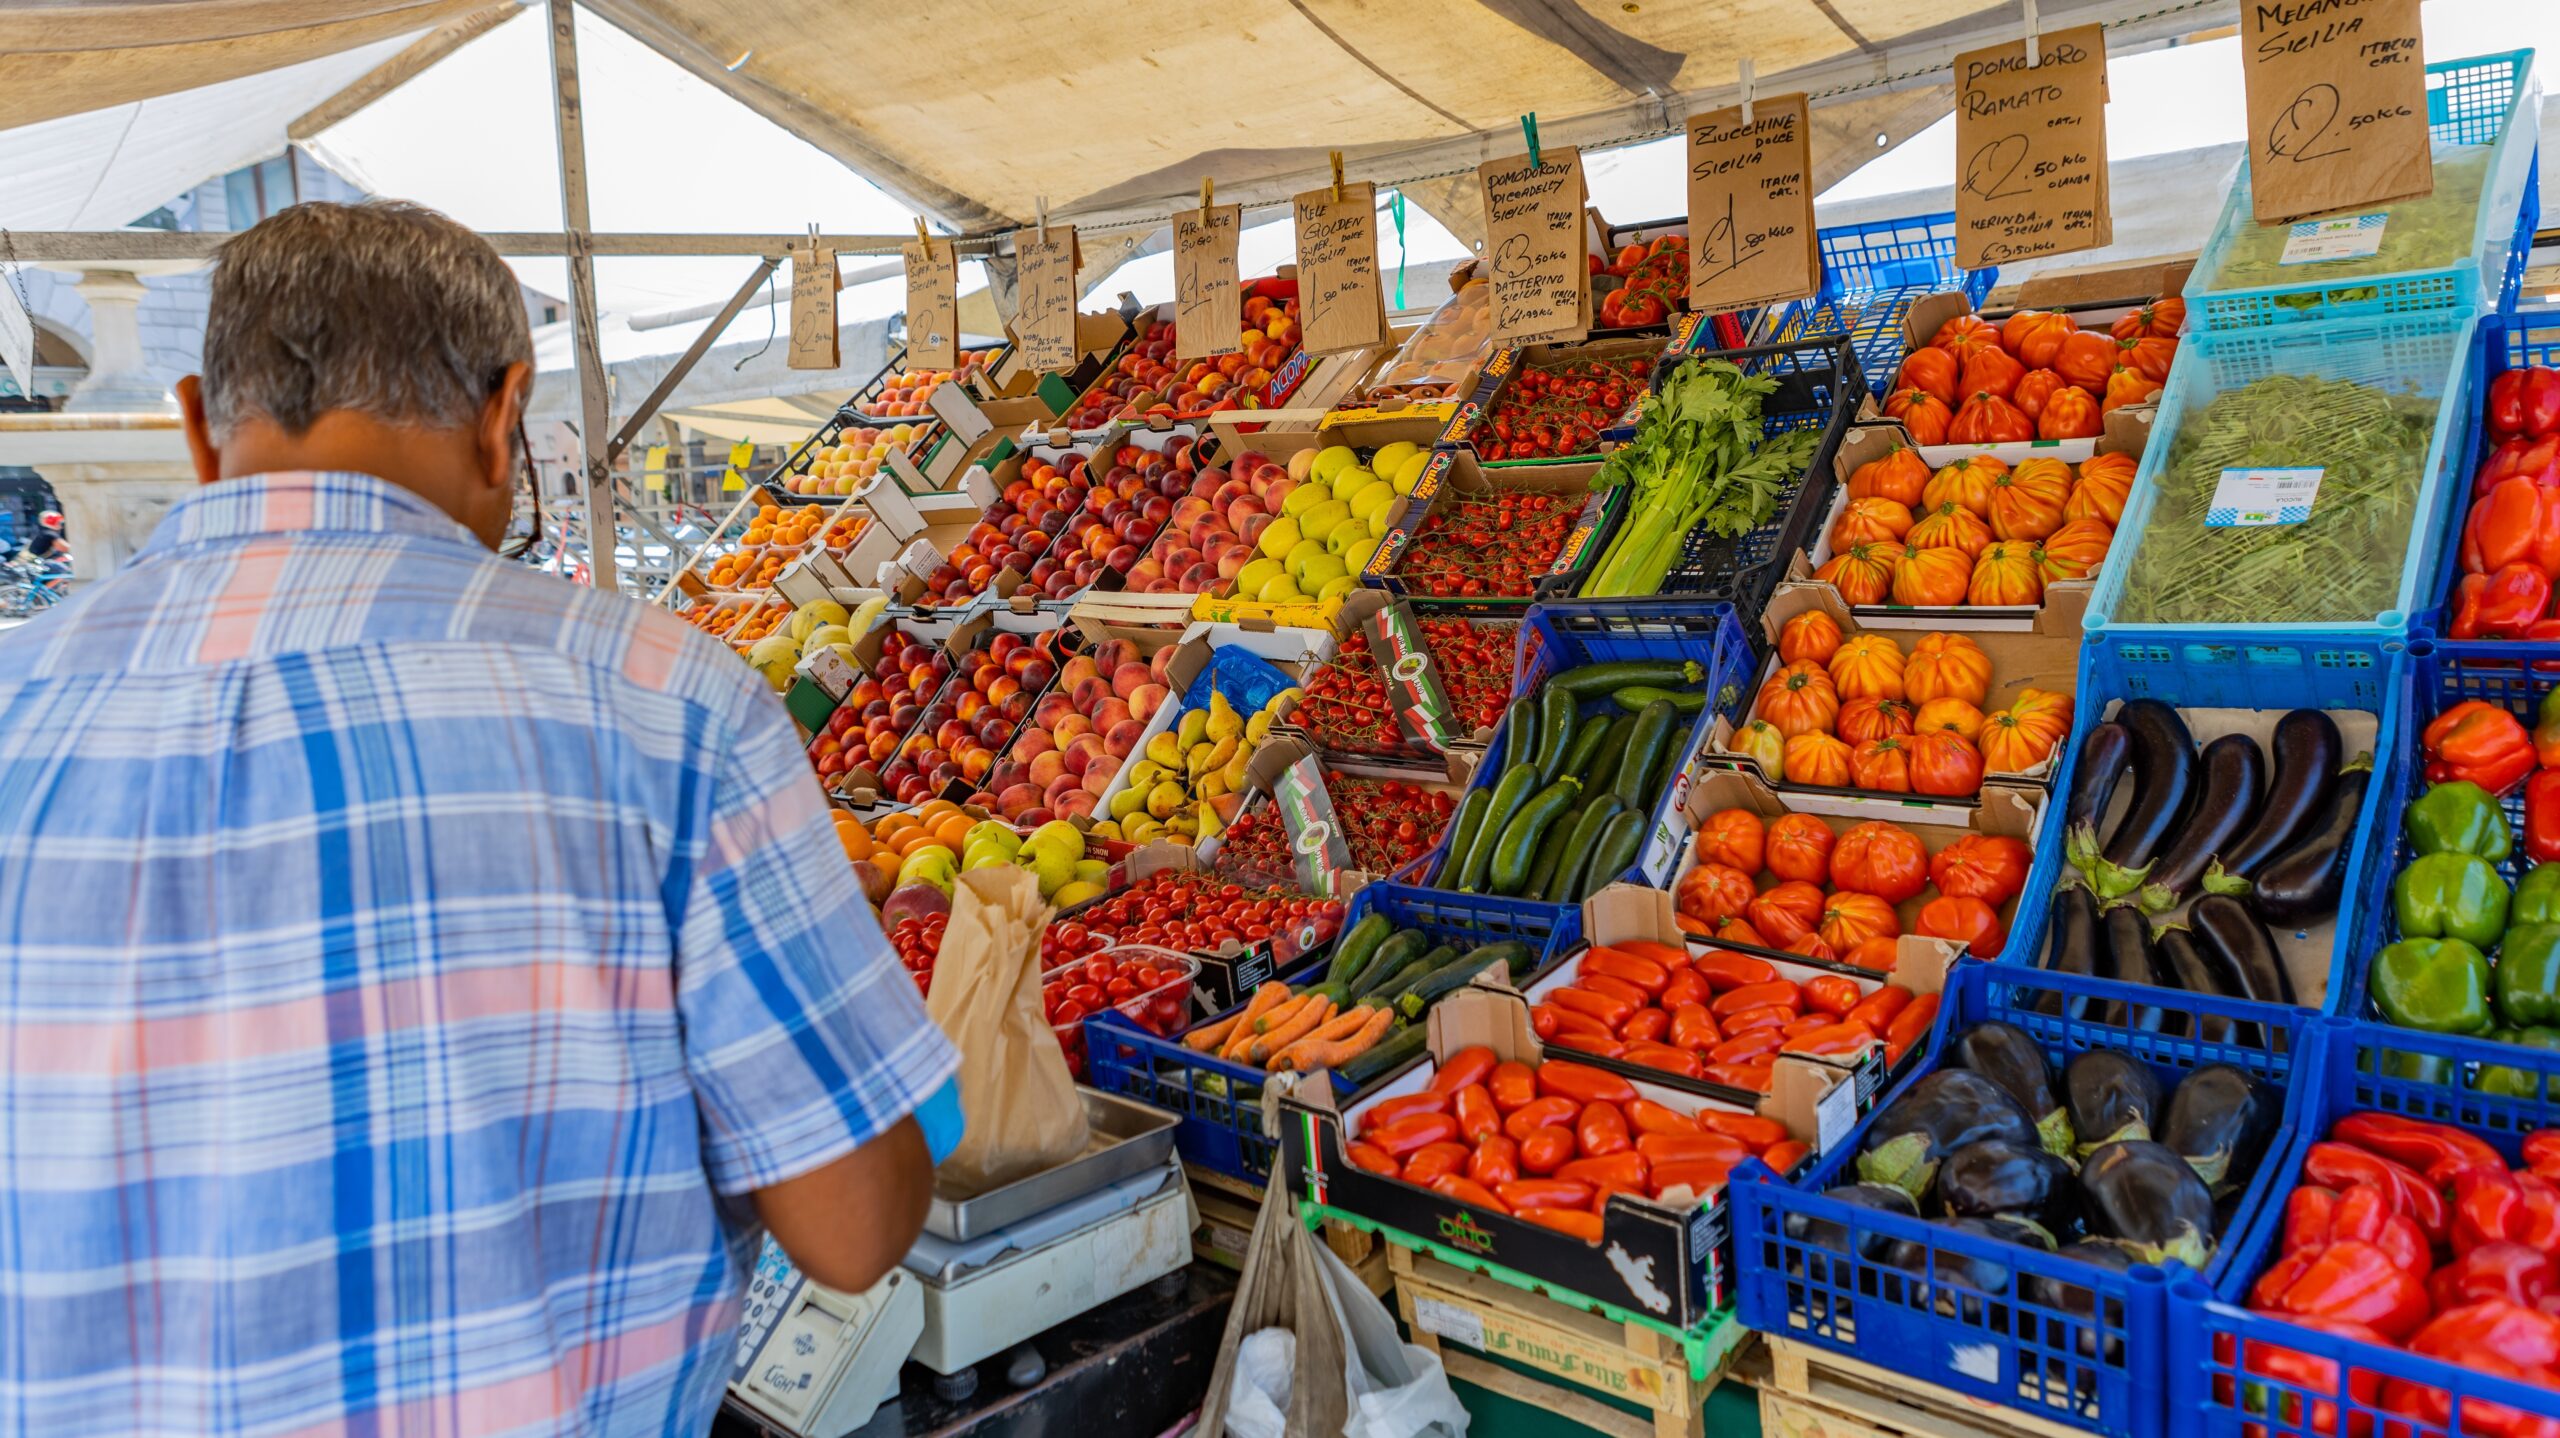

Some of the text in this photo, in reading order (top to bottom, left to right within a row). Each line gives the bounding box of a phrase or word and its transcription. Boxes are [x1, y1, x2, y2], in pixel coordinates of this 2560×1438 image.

[2258, 17, 2364, 63] SICILIA
[1961, 84, 2063, 121] RAMATO
[1694, 112, 1796, 146] ZUCCHINE
[1755, 131, 1795, 148] DOLCE
[1693, 152, 1763, 182] SICILIA
[1760, 173, 1800, 189] ITALIA
[1299, 203, 1329, 224] MELE
[1492, 201, 1540, 224] SICILIA
[1179, 214, 1231, 239] ARNCIE
[1303, 216, 1366, 240] GOLDEN
[2003, 218, 2054, 237] SICILIA
[1301, 246, 1347, 275] PUGLIA
[1494, 274, 1565, 294] DATTERINO
[1515, 1337, 1581, 1372] Frutta
[1582, 1360, 1628, 1392] Alta
